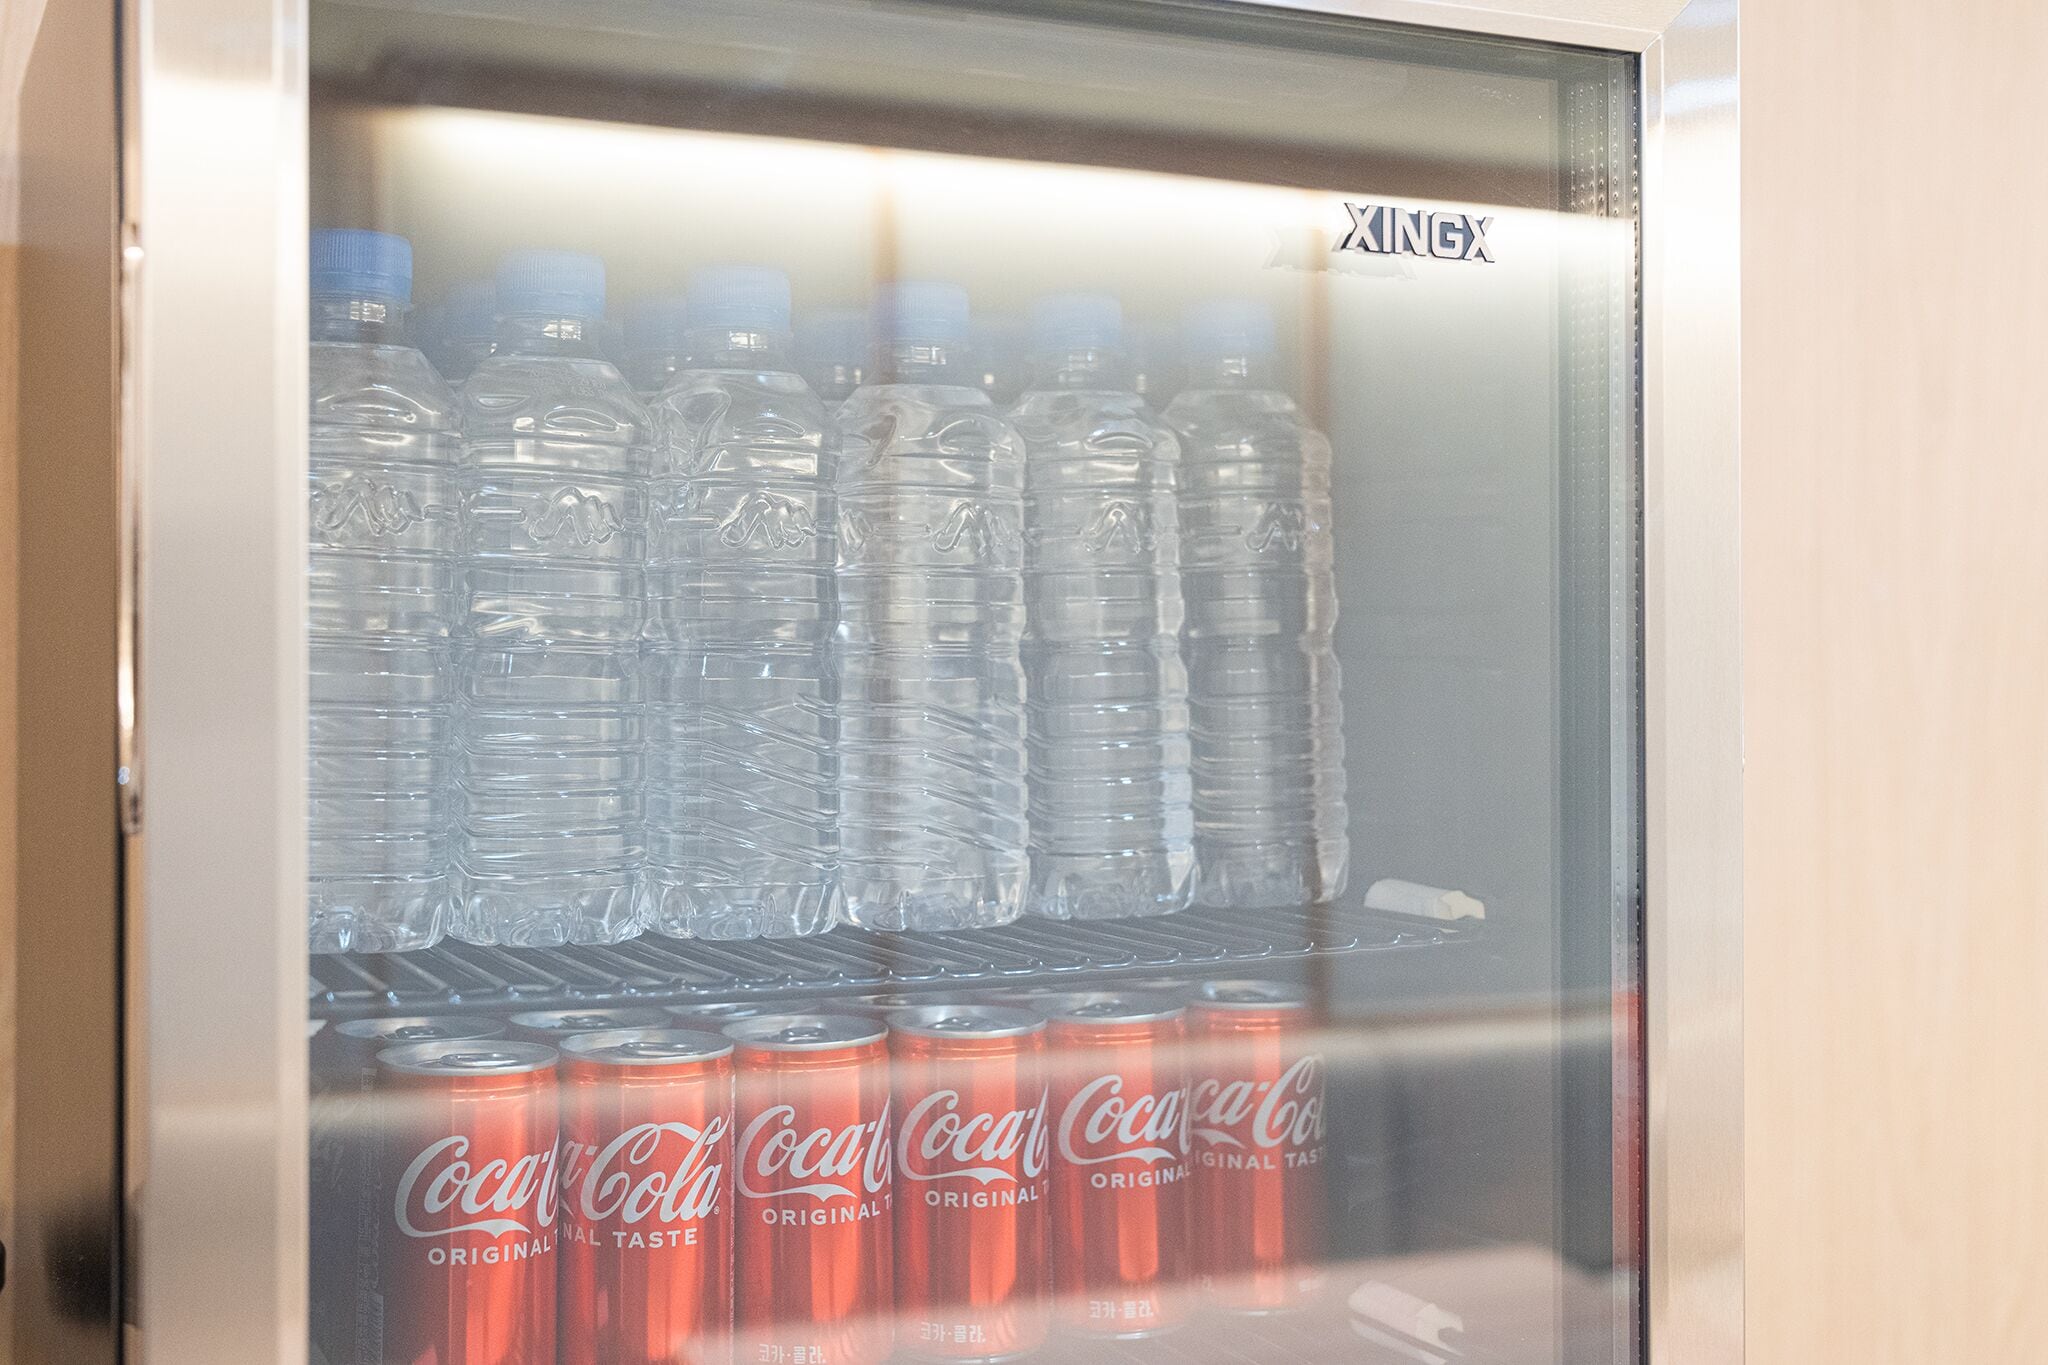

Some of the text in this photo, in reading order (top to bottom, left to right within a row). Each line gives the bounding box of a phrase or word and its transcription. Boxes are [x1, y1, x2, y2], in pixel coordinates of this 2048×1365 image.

[1340, 202, 1495, 263] XINGX
[1090, 1162, 1191, 1189] ORIGINAL
[924, 1185, 1039, 1208] ORIGINAL
[762, 1201, 881, 1226] ORIGINAL
[427, 1235, 551, 1266] ORIGINAL
[612, 1227, 698, 1249] TASTE
